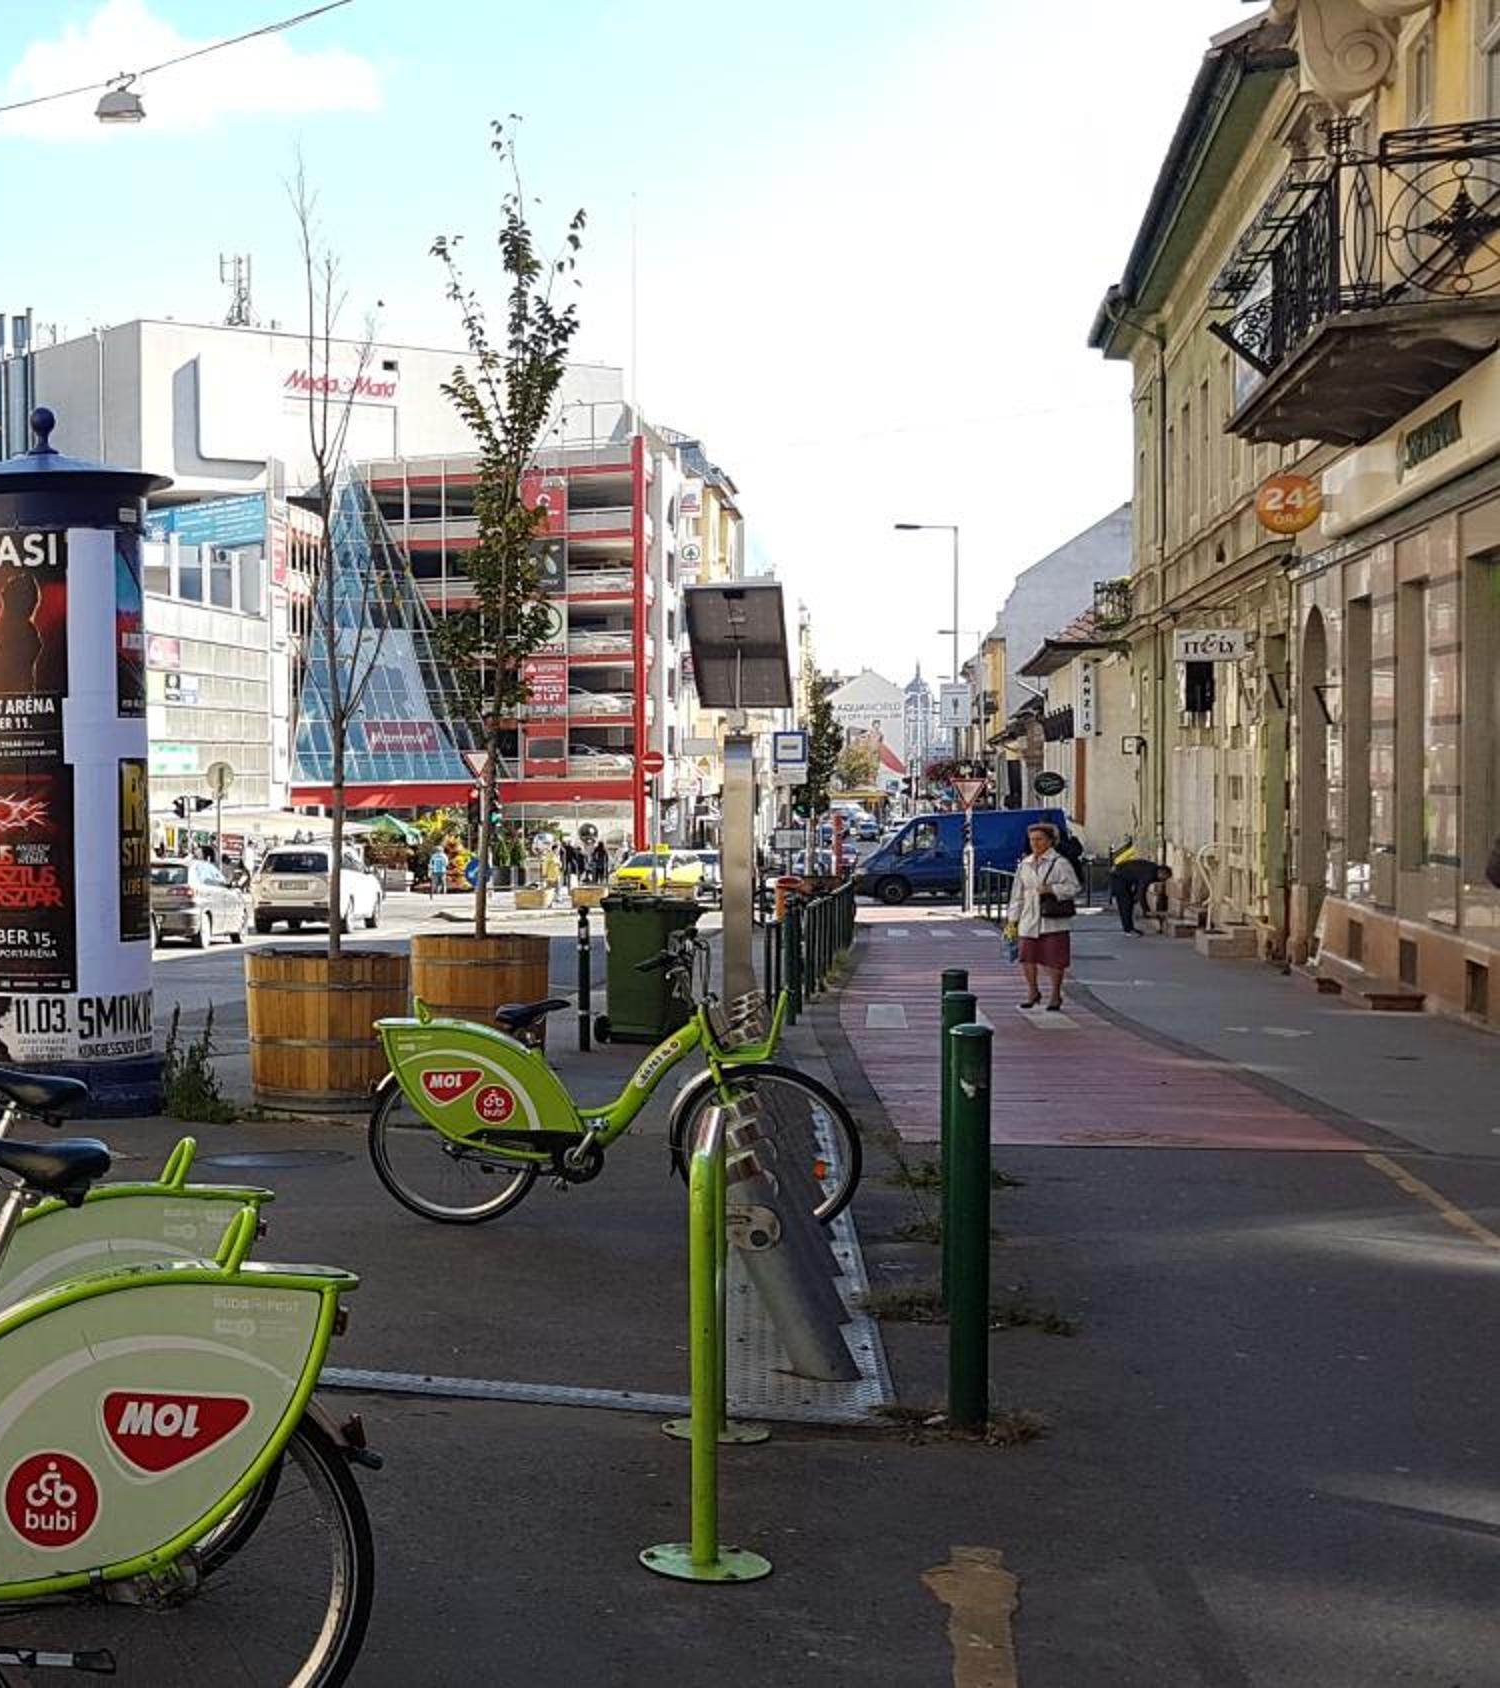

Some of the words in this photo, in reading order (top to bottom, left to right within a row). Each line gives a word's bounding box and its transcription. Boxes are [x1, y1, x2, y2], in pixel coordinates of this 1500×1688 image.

[283, 369, 338, 393] Media
[1266, 487, 1305, 511] 24
[5, 695, 55, 715] ARÉNA
[15, 717, 34, 730] 11.
[33, 931, 57, 947] 15.
[15, 997, 72, 1034] 11.03.
[428, 1074, 462, 1088] MOL
[117, 1401, 200, 1438] MOL
[25, 1509, 77, 1531] bubi
